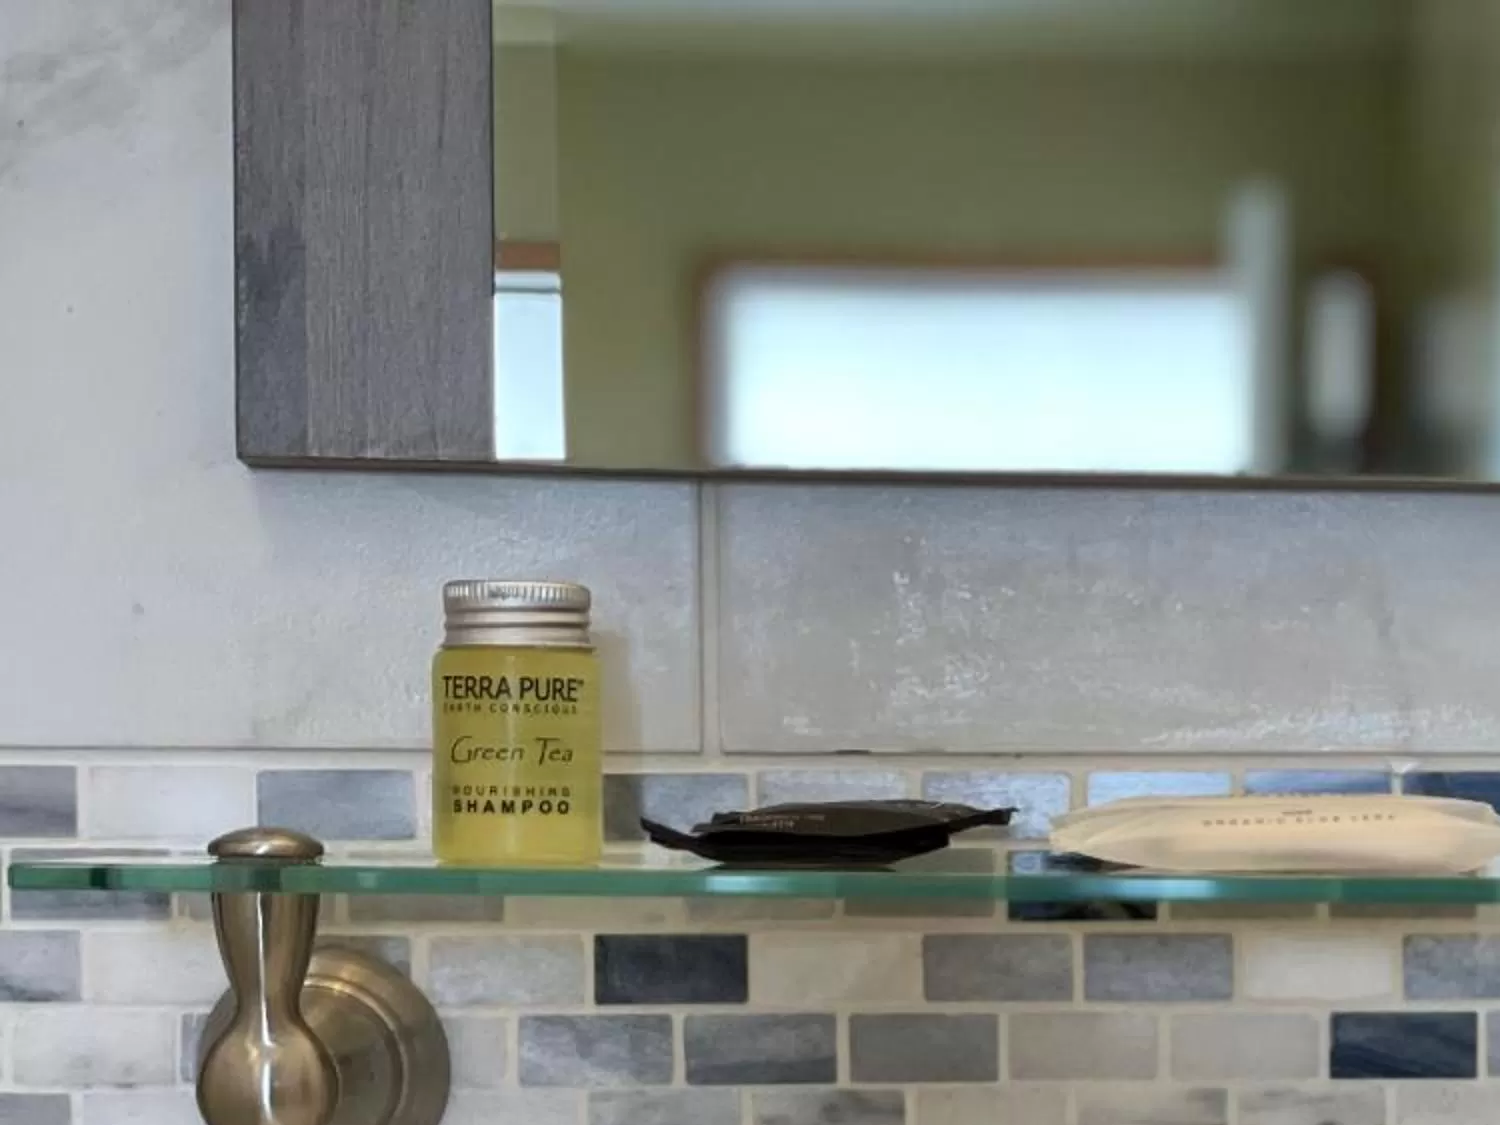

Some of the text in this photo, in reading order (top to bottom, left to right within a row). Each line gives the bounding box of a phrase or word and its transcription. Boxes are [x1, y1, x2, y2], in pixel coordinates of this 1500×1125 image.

[442, 675, 511, 699] TERRA
[450, 735, 573, 765] Green Tea
[453, 799, 570, 816] SHAMPOO
